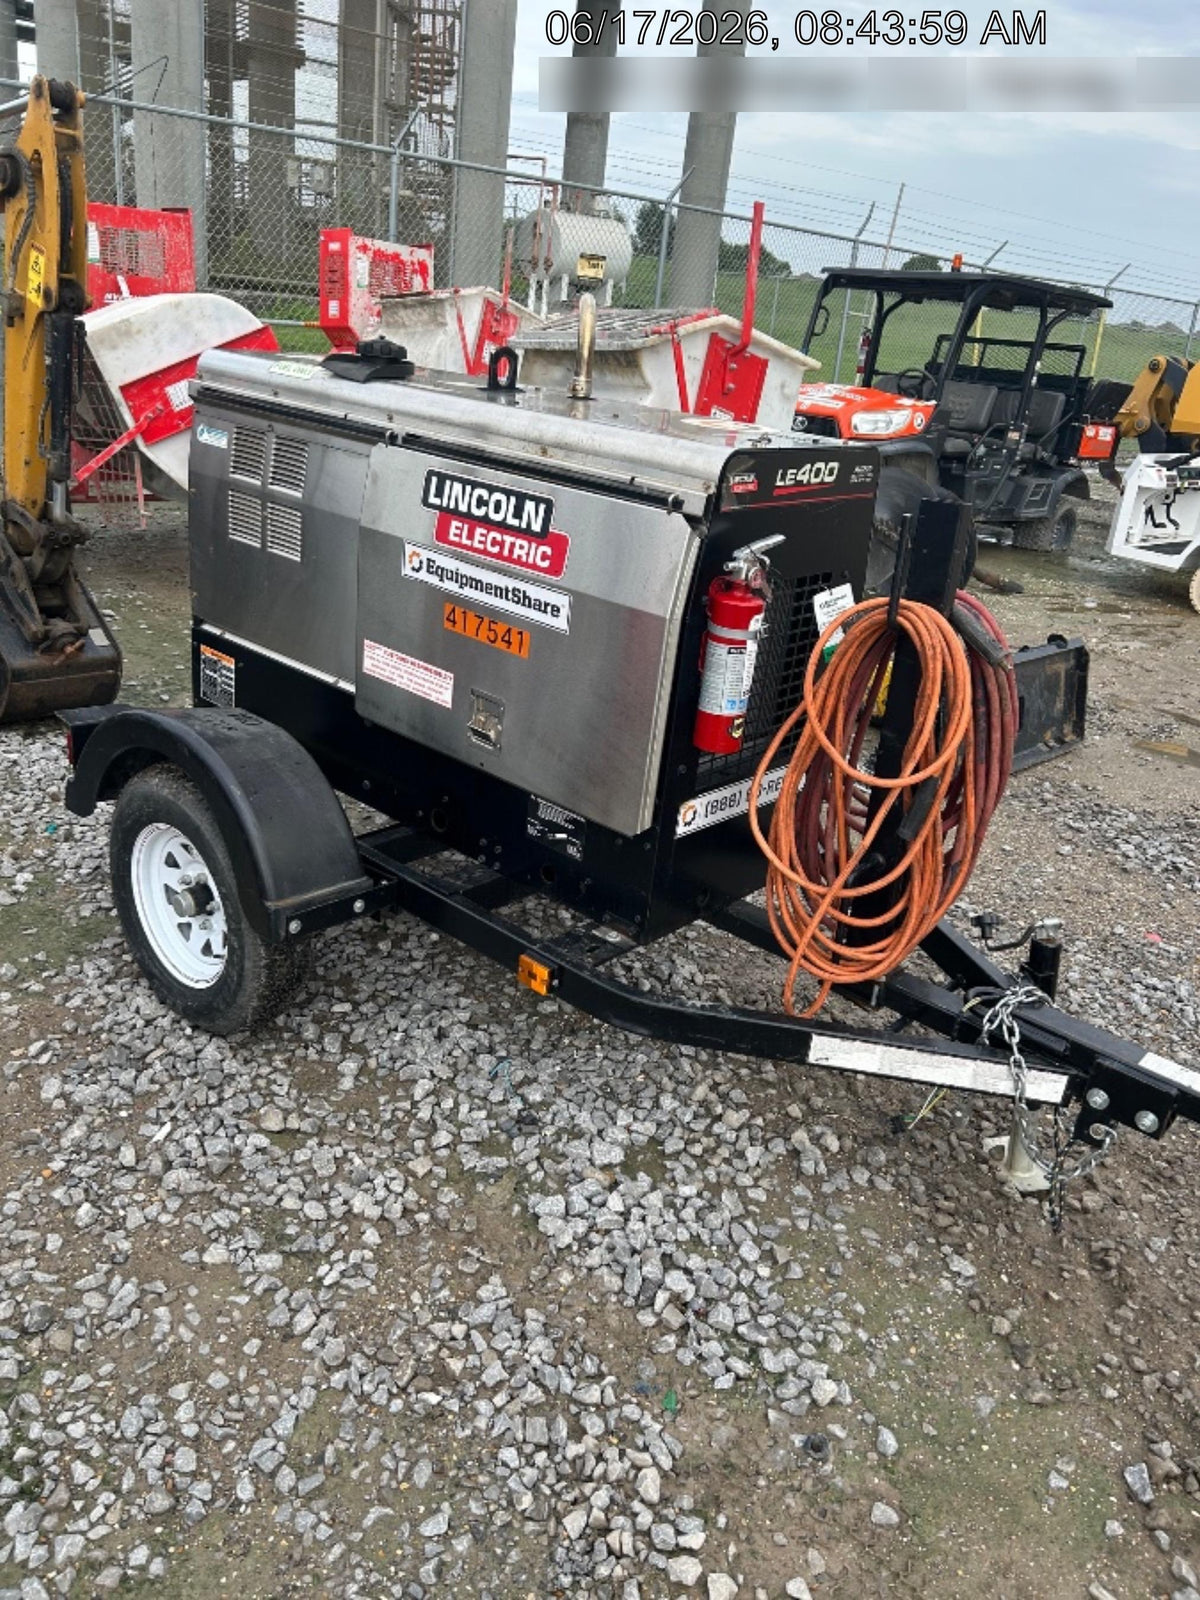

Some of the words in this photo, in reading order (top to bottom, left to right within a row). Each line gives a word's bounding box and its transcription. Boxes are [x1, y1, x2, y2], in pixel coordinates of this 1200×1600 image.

[775, 461, 839, 486] LE400
[428, 475, 547, 533] LINCOLN
[449, 520, 552, 568] ELECTRIC
[426, 557, 561, 618] EquipmentShare
[445, 605, 524, 653] 417541
[705, 789, 742, 818] (888)
